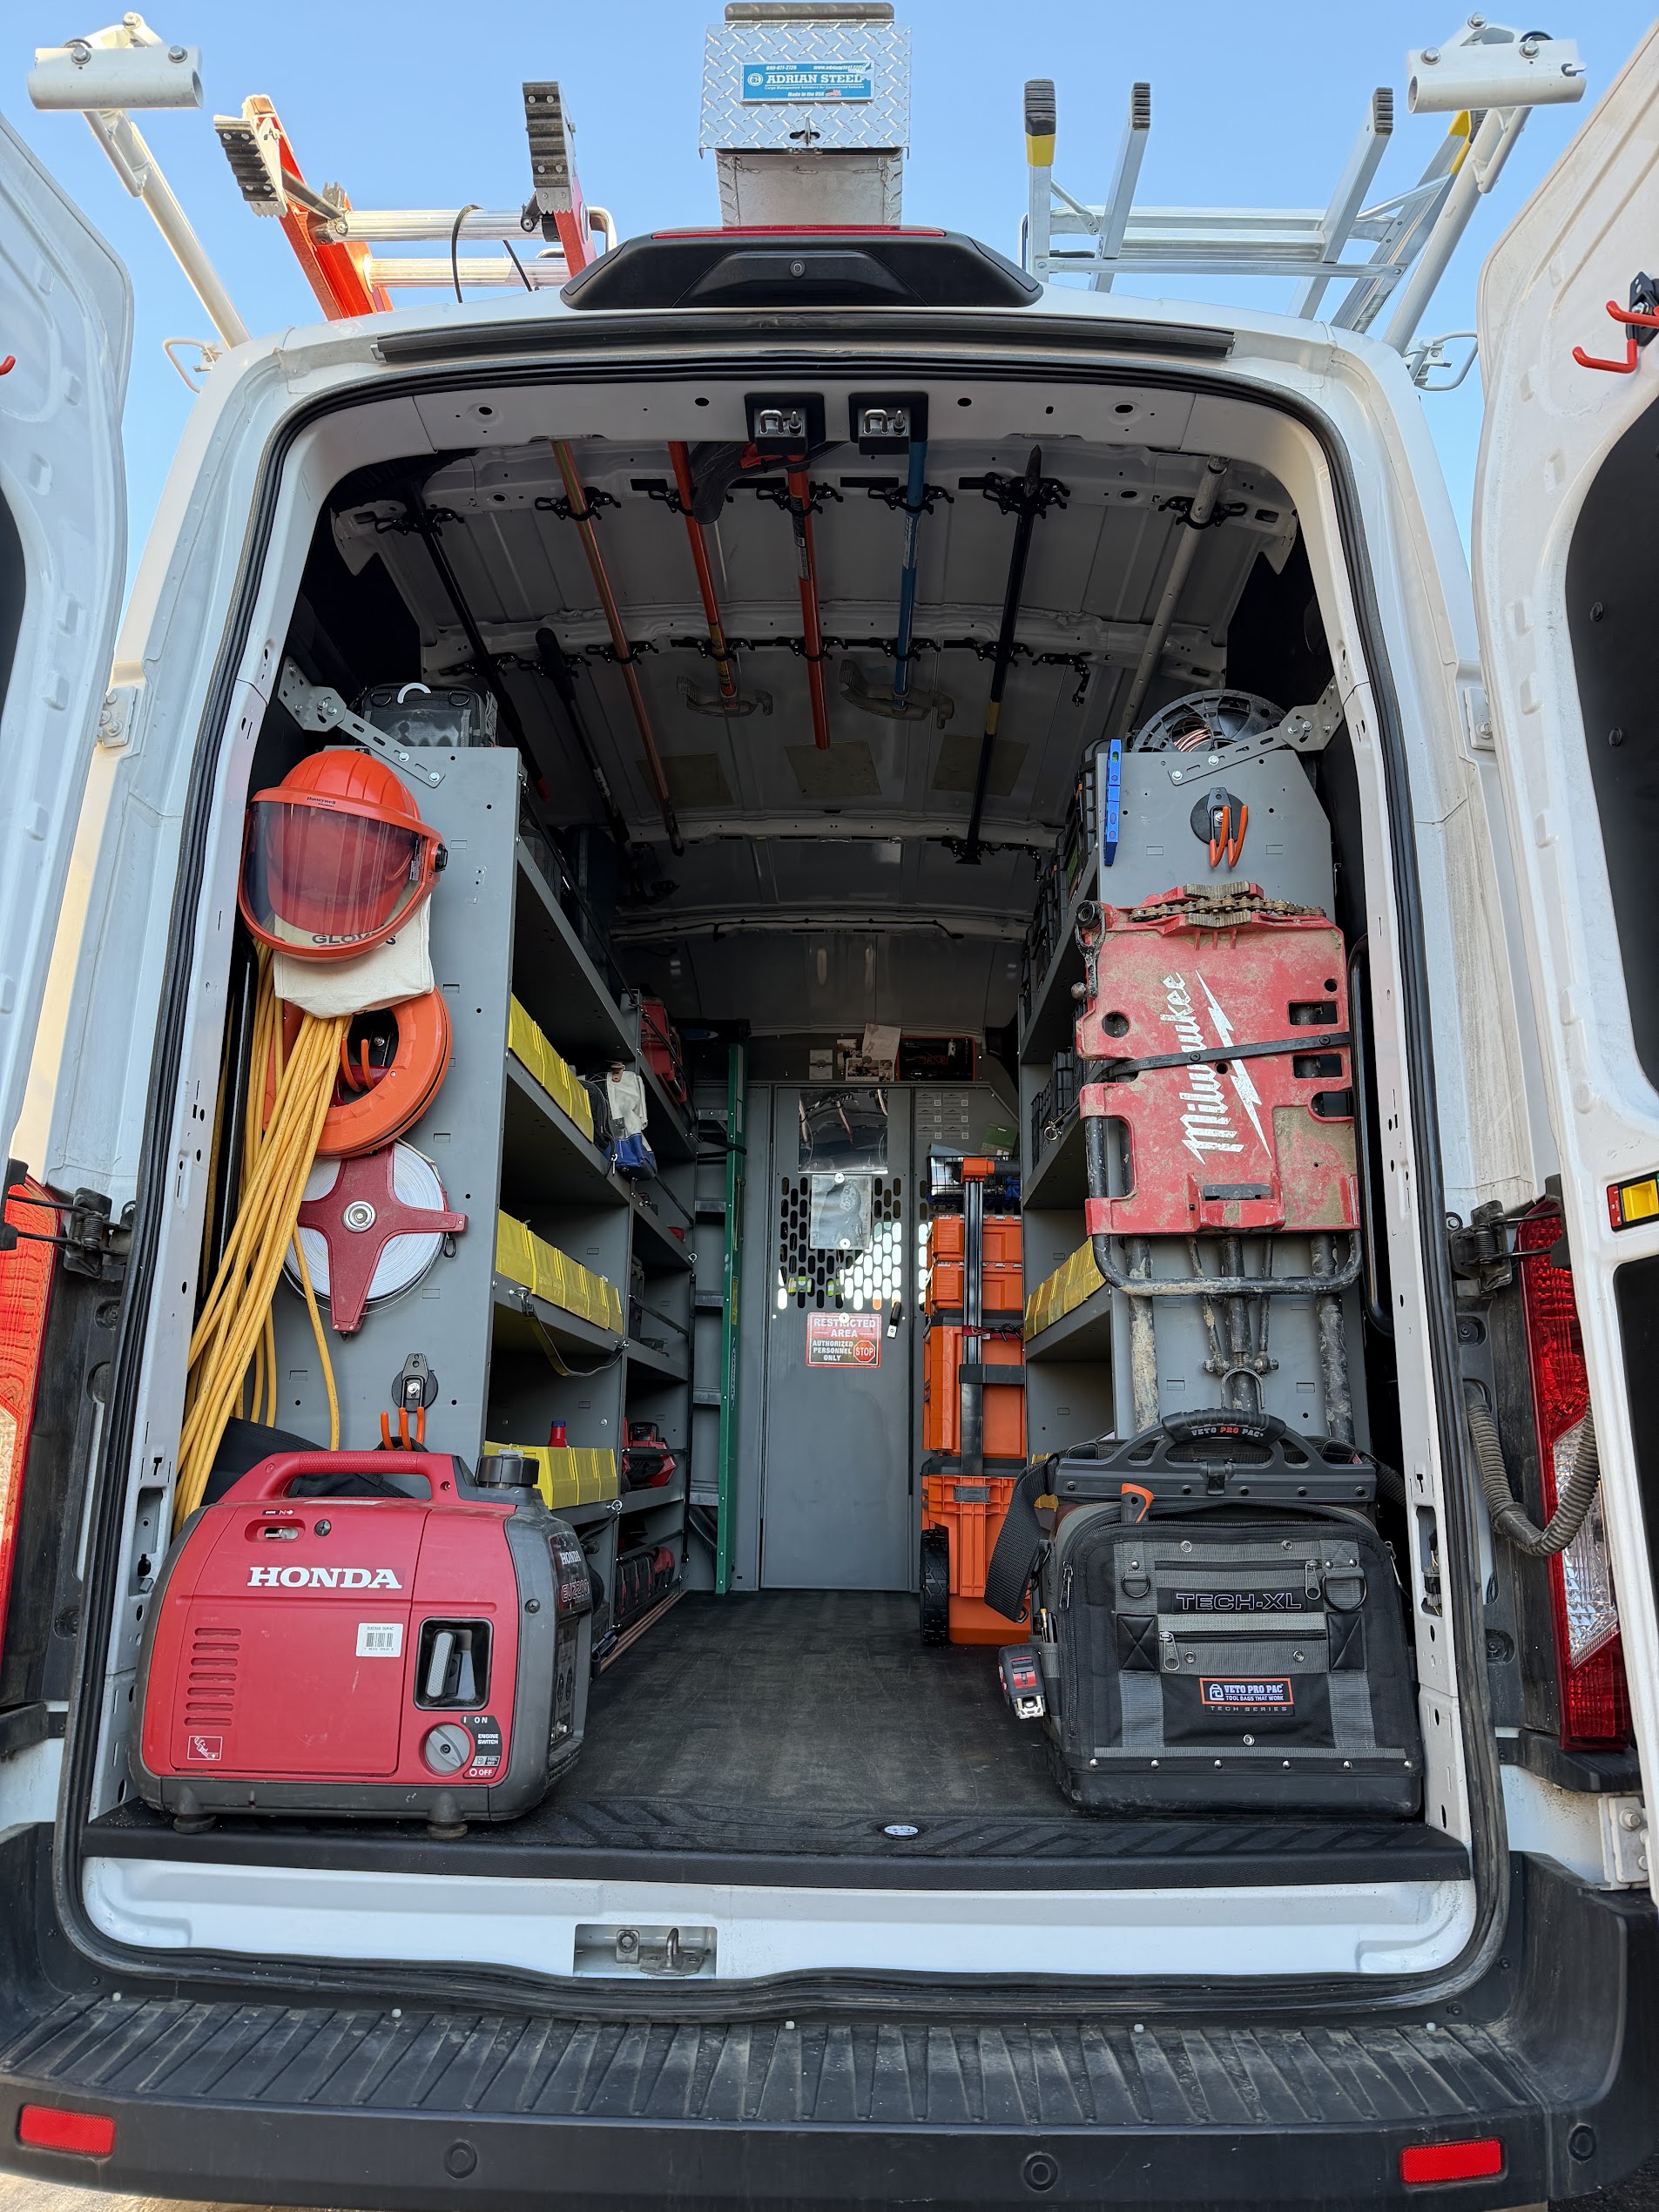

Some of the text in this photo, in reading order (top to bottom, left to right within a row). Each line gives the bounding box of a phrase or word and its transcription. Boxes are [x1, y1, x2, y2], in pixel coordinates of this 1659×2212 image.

[765, 73, 863, 84] ADRIAN STEEL
[307, 796, 337, 805] Honeywell
[312, 933, 396, 945] GLOVS
[830, 1329, 858, 1338] AREA
[855, 1346, 874, 1356] STOP
[1190, 1426, 1217, 1436] VETO
[560, 1550, 582, 1565] HONDA
[246, 1566, 403, 1590] HONDA
[1176, 1592, 1302, 1610] TECH-XL
[1223, 1684, 1245, 1694] VETO
[1247, 1684, 1264, 1694] PRO
